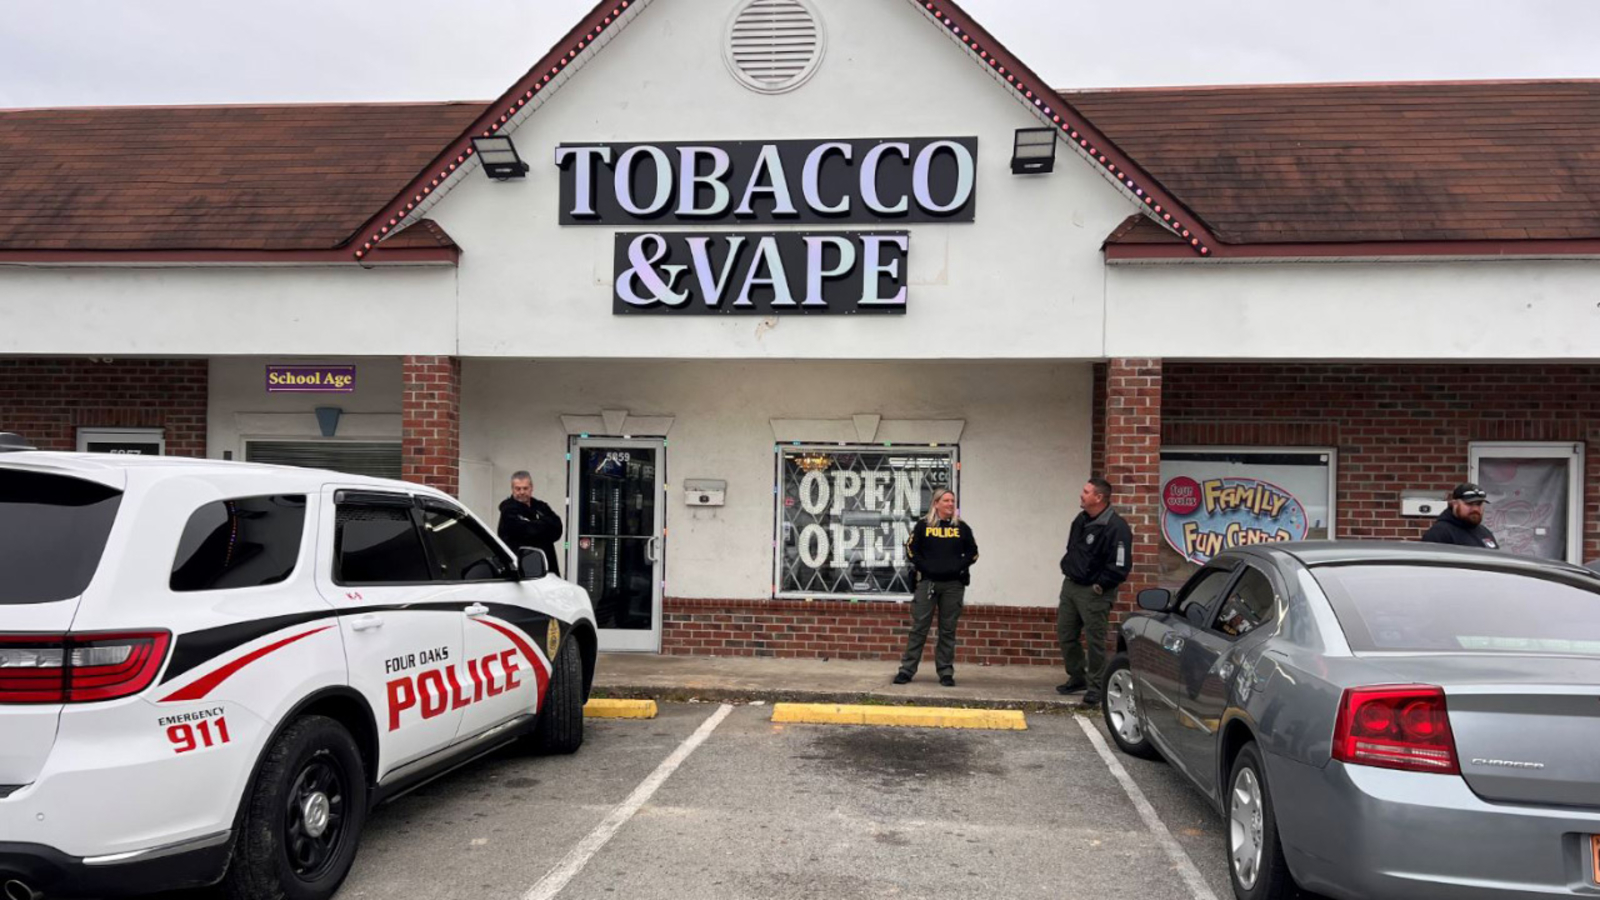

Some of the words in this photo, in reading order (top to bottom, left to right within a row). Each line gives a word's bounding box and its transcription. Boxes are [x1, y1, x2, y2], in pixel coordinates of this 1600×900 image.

[555, 140, 974, 217] TOBACCO
[614, 233, 909, 306] &VAPE
[269, 372, 320, 384] School
[323, 372, 352, 388] Age
[606, 451, 630, 461] 5859
[800, 470, 924, 516] OPEN
[1203, 479, 1289, 518] FAMILY
[925, 527, 961, 538] POLICE
[385, 654, 416, 674] FOUR
[420, 646, 449, 665] OAKS
[386, 648, 521, 732] POLICE
[158, 706, 225, 726] EMERGENCY
[166, 716, 230, 754] 911
